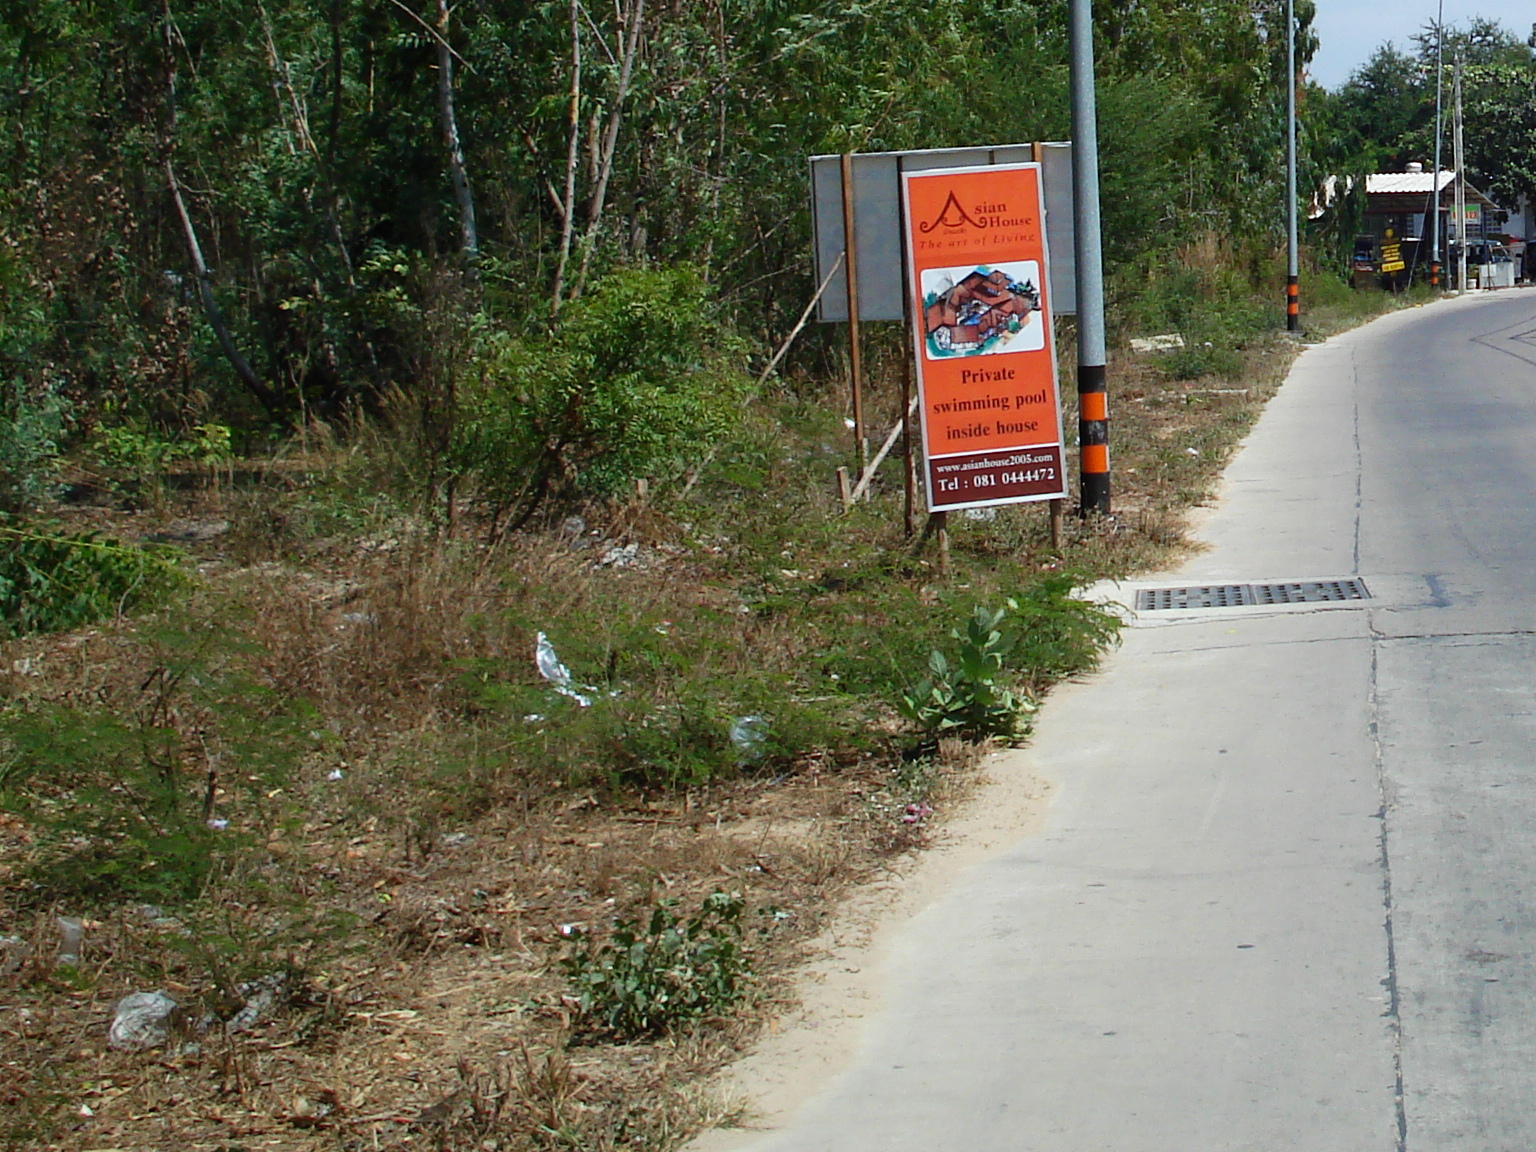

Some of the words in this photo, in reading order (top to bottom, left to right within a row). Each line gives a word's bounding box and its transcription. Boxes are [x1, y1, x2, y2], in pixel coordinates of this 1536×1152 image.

[989, 216, 1032, 228] House
[920, 240, 942, 249] The
[948, 239, 967, 247] art
[975, 237, 986, 246] of
[993, 234, 1035, 244] Living
[961, 367, 1016, 384] Private
[933, 395, 1010, 414] swimming
[1016, 389, 1047, 409] pool
[946, 423, 990, 440] inside
[996, 420, 1039, 434] house
[936, 454, 1053, 473] www.asianhouse2005.com
[938, 477, 959, 491] Tel
[973, 474, 996, 488] 081
[1002, 468, 1055, 484] 0444472
